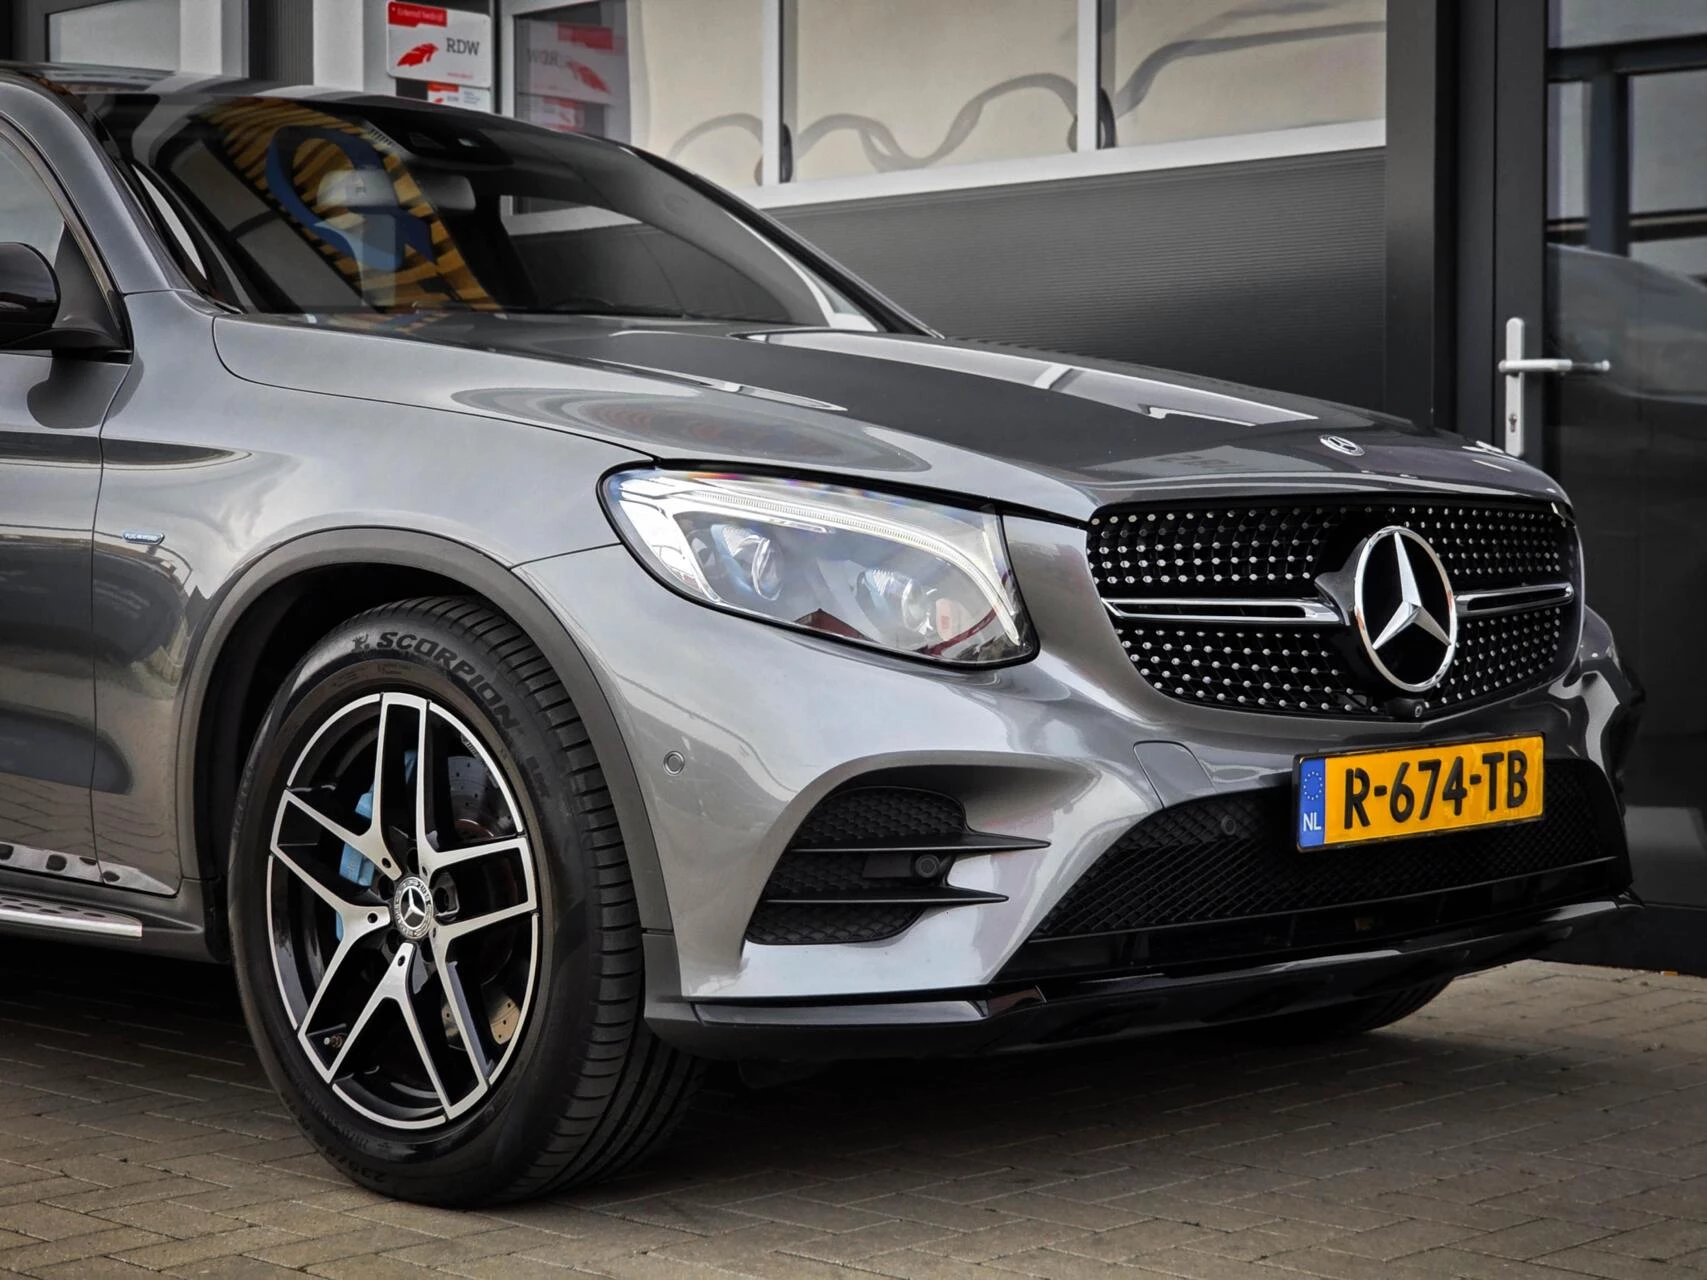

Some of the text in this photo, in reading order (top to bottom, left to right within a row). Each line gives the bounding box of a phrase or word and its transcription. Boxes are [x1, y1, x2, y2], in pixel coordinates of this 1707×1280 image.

[446, 37, 480, 56] RDW
[376, 631, 521, 729] SCORPION
[1343, 750, 1528, 830] R-674-TB
[1302, 812, 1322, 832] NL
